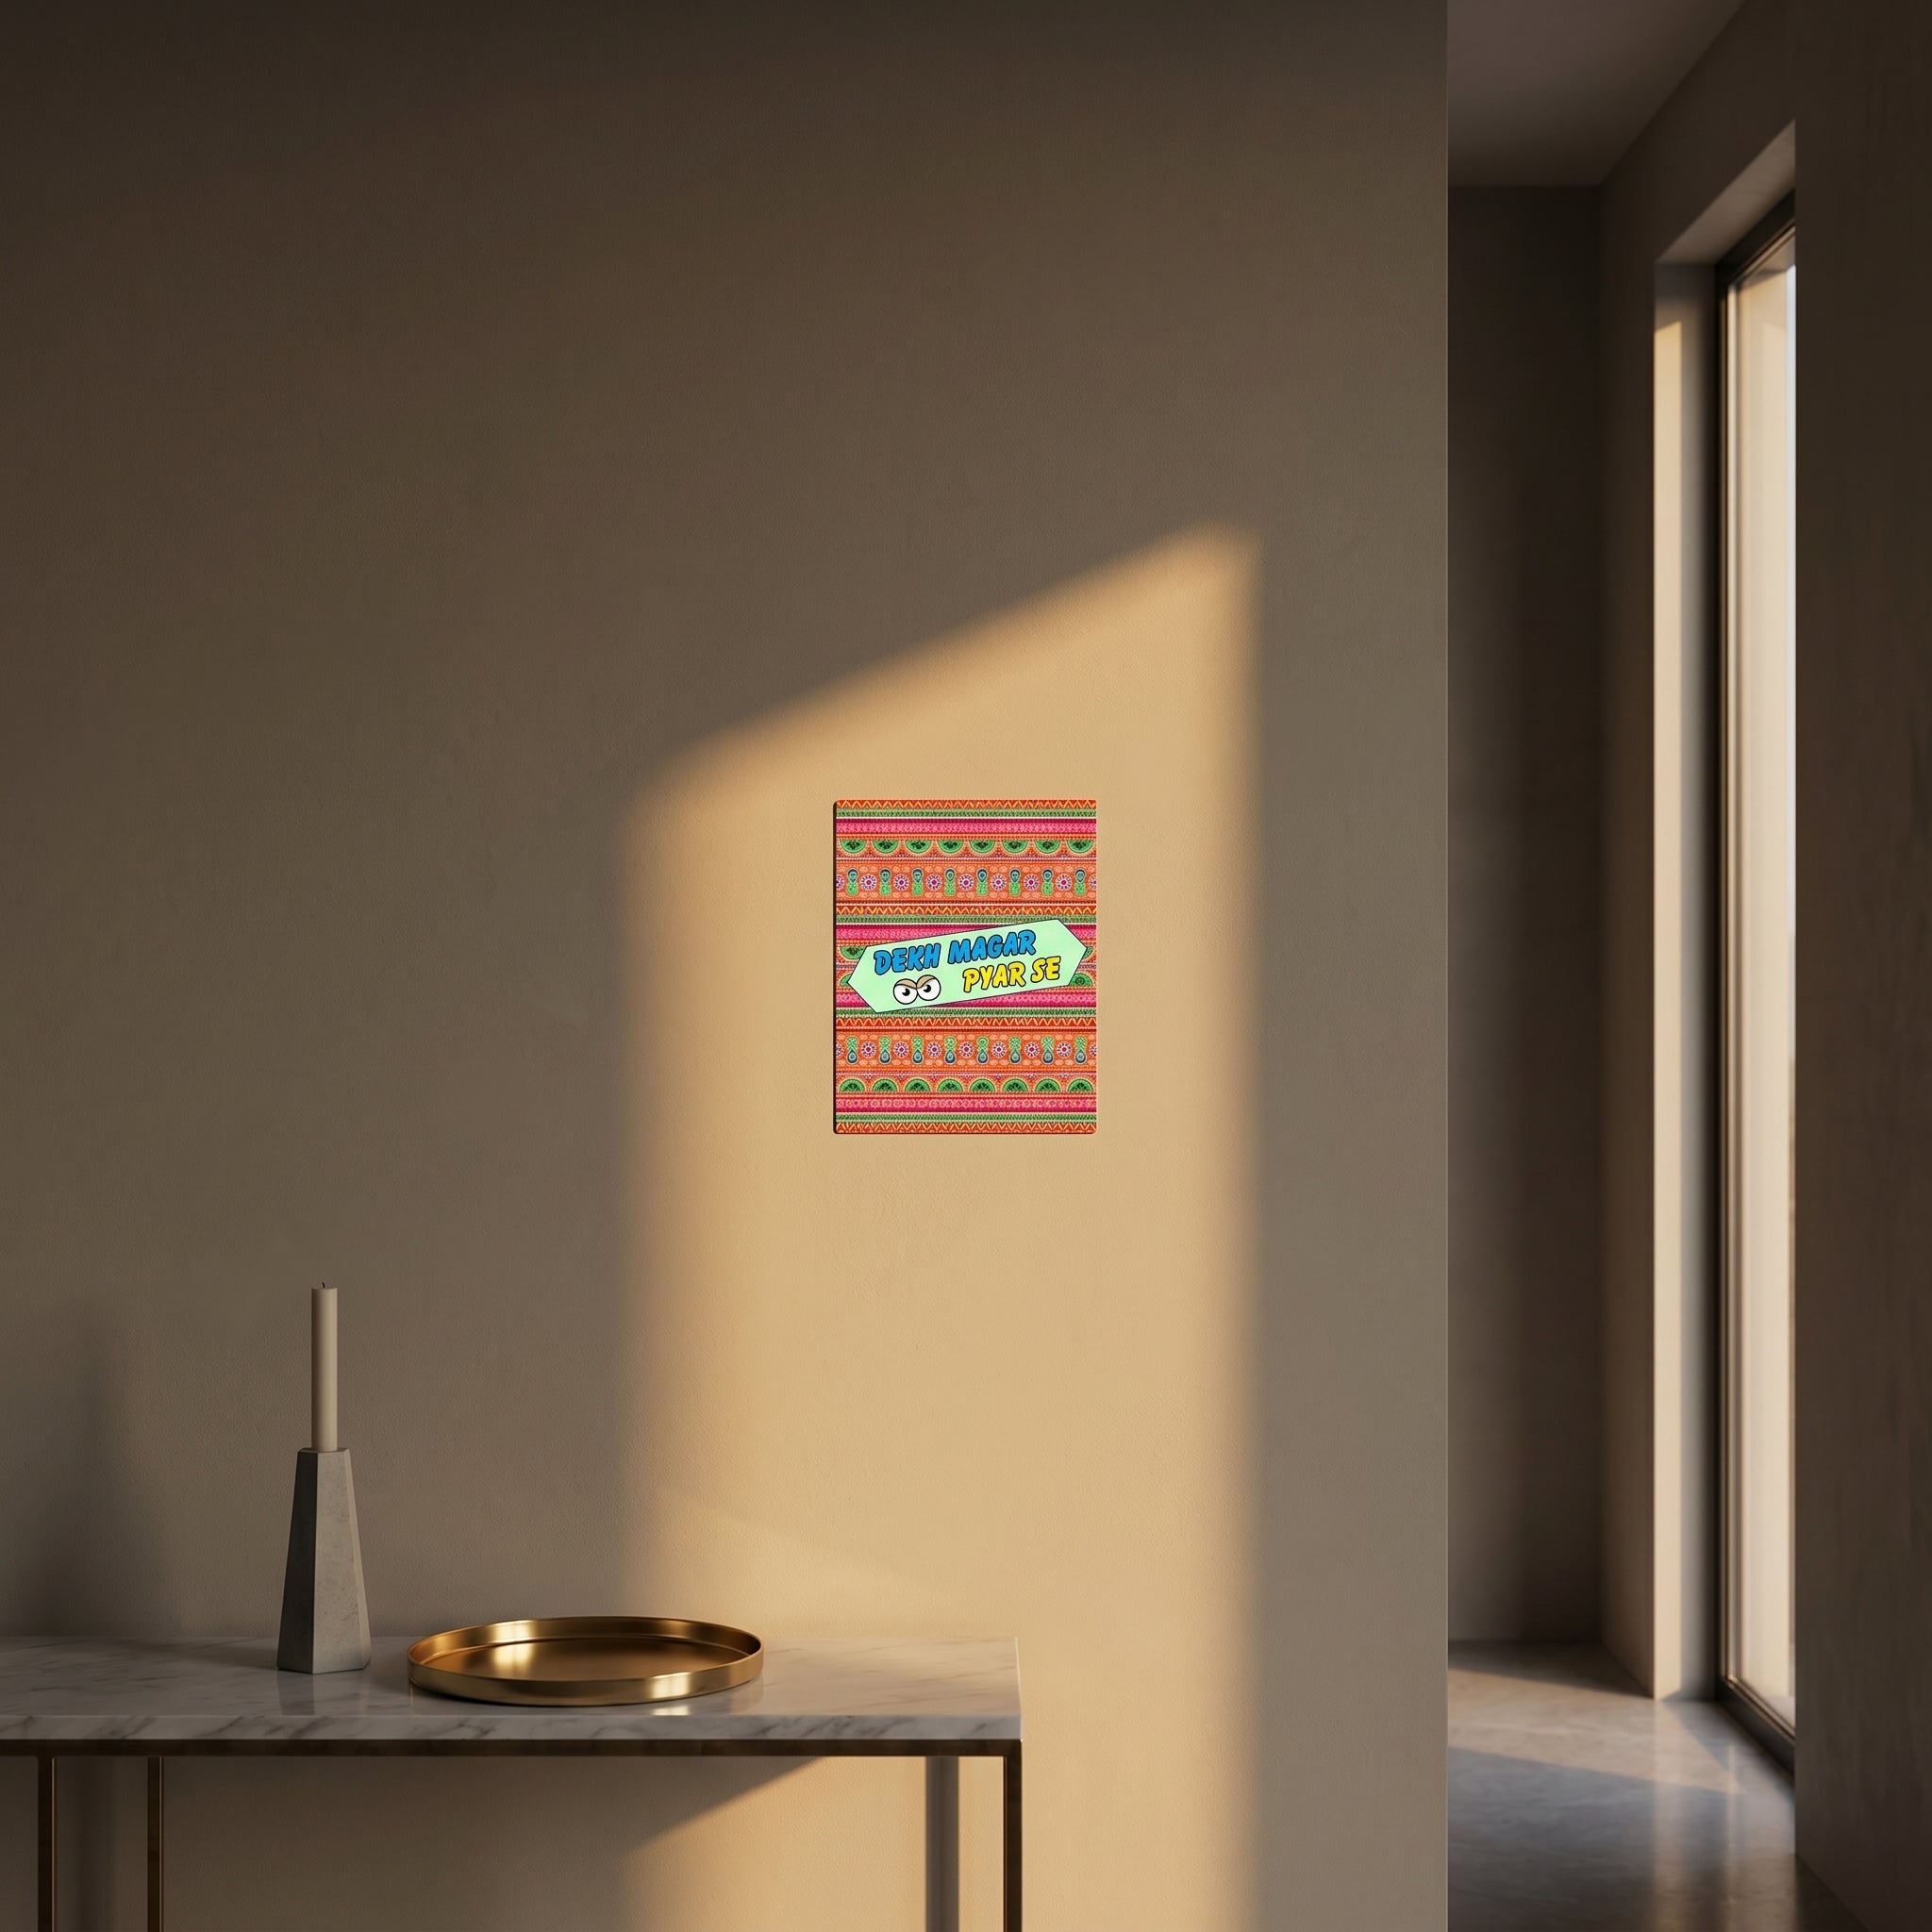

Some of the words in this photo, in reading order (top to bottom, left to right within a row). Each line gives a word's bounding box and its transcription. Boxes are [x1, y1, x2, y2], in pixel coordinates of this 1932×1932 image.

[874, 943, 941, 975] DEKH
[947, 929, 1037, 964] MAGAR
[962, 961, 1026, 993] PYAR
[1030, 956, 1062, 983] SE
